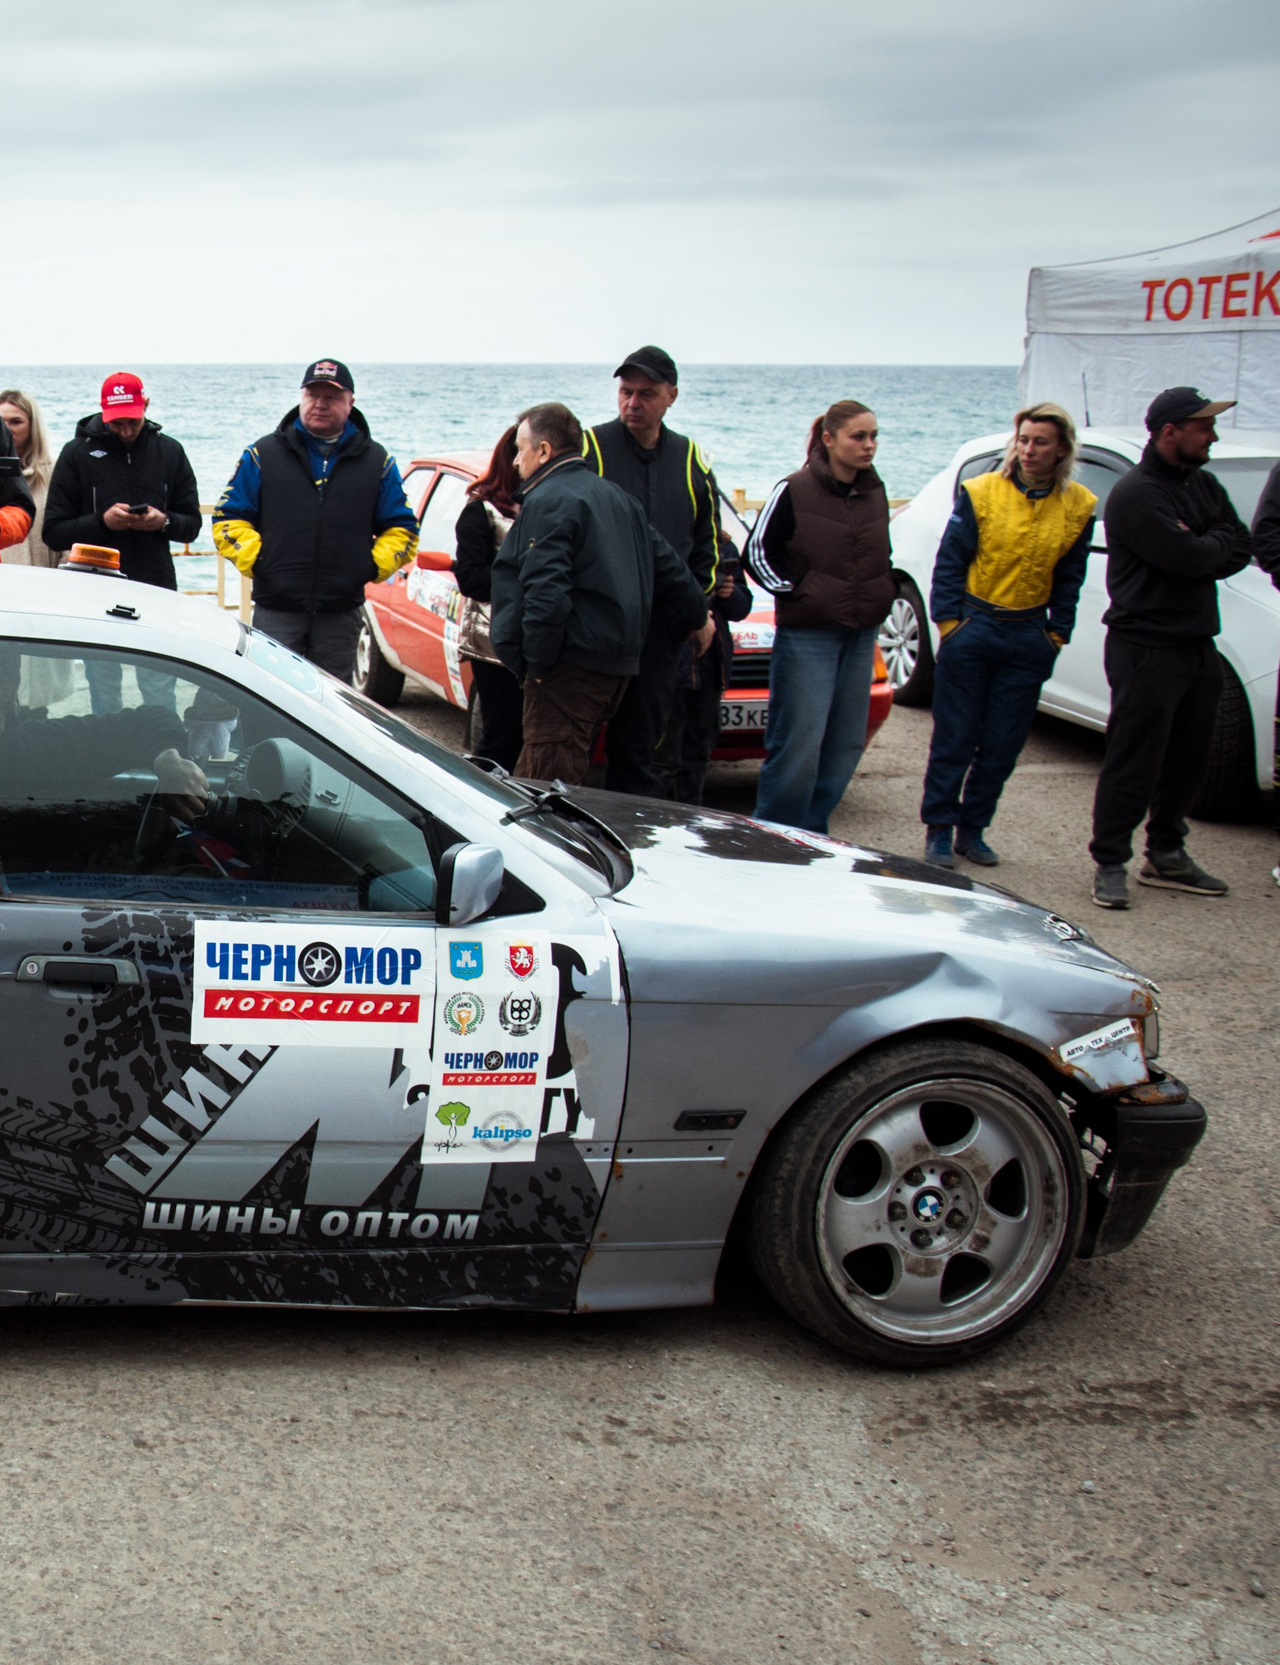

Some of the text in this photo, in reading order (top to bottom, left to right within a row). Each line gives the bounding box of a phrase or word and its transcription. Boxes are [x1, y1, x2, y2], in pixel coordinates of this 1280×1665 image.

[215, 997, 412, 1015] МОТОРСПОРТ
[1067, 1025, 1131, 1057] АВТО ТЕХ ЦЕНТР
[447, 1075, 533, 1083] МОТОРСПОРТ
[472, 1124, 532, 1142] kalipso
